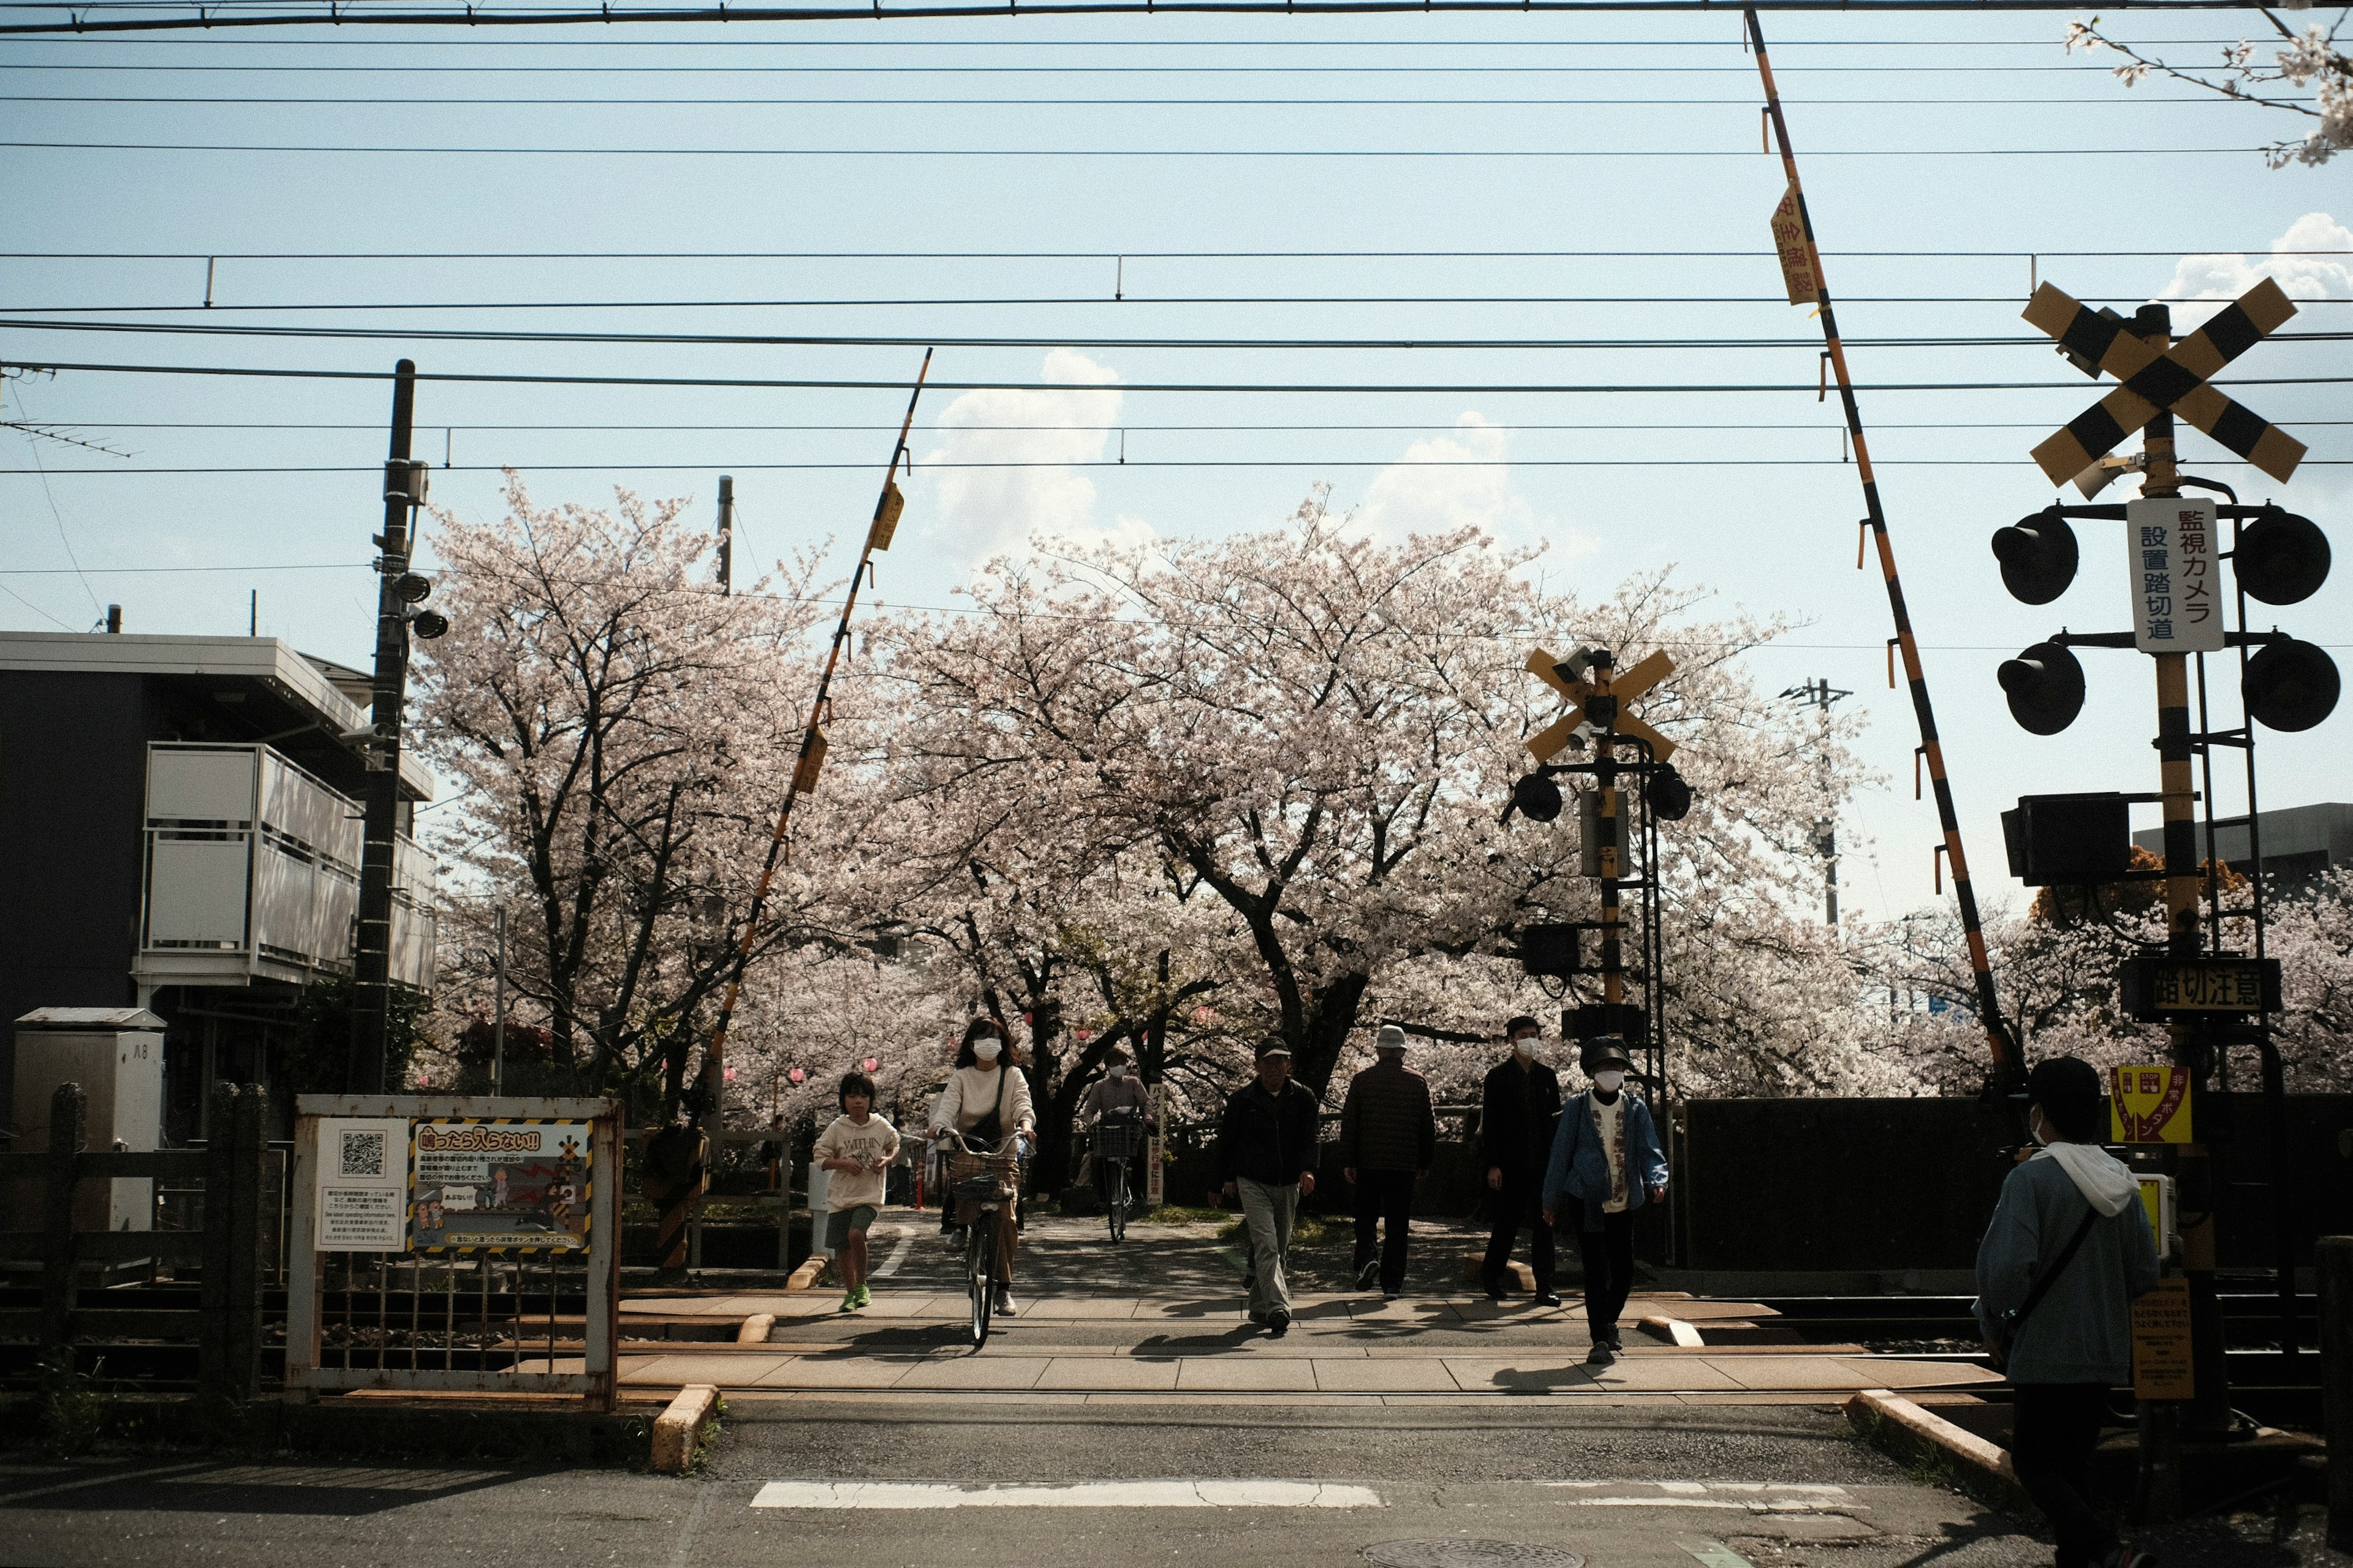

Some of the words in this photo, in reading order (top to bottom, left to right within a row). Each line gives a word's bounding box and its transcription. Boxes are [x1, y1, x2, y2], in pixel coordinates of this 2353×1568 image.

[1777, 195, 1814, 295] 安全確認
[2140, 526, 2175, 640] 設置踏切道
[2178, 510, 2210, 624] 監視カメラ
[2155, 967, 2260, 1006] 踏切注意
[422, 1134, 538, 1148] 鳴ったら入らない!!
[2142, 1074, 2184, 1136] 非常ボタン
